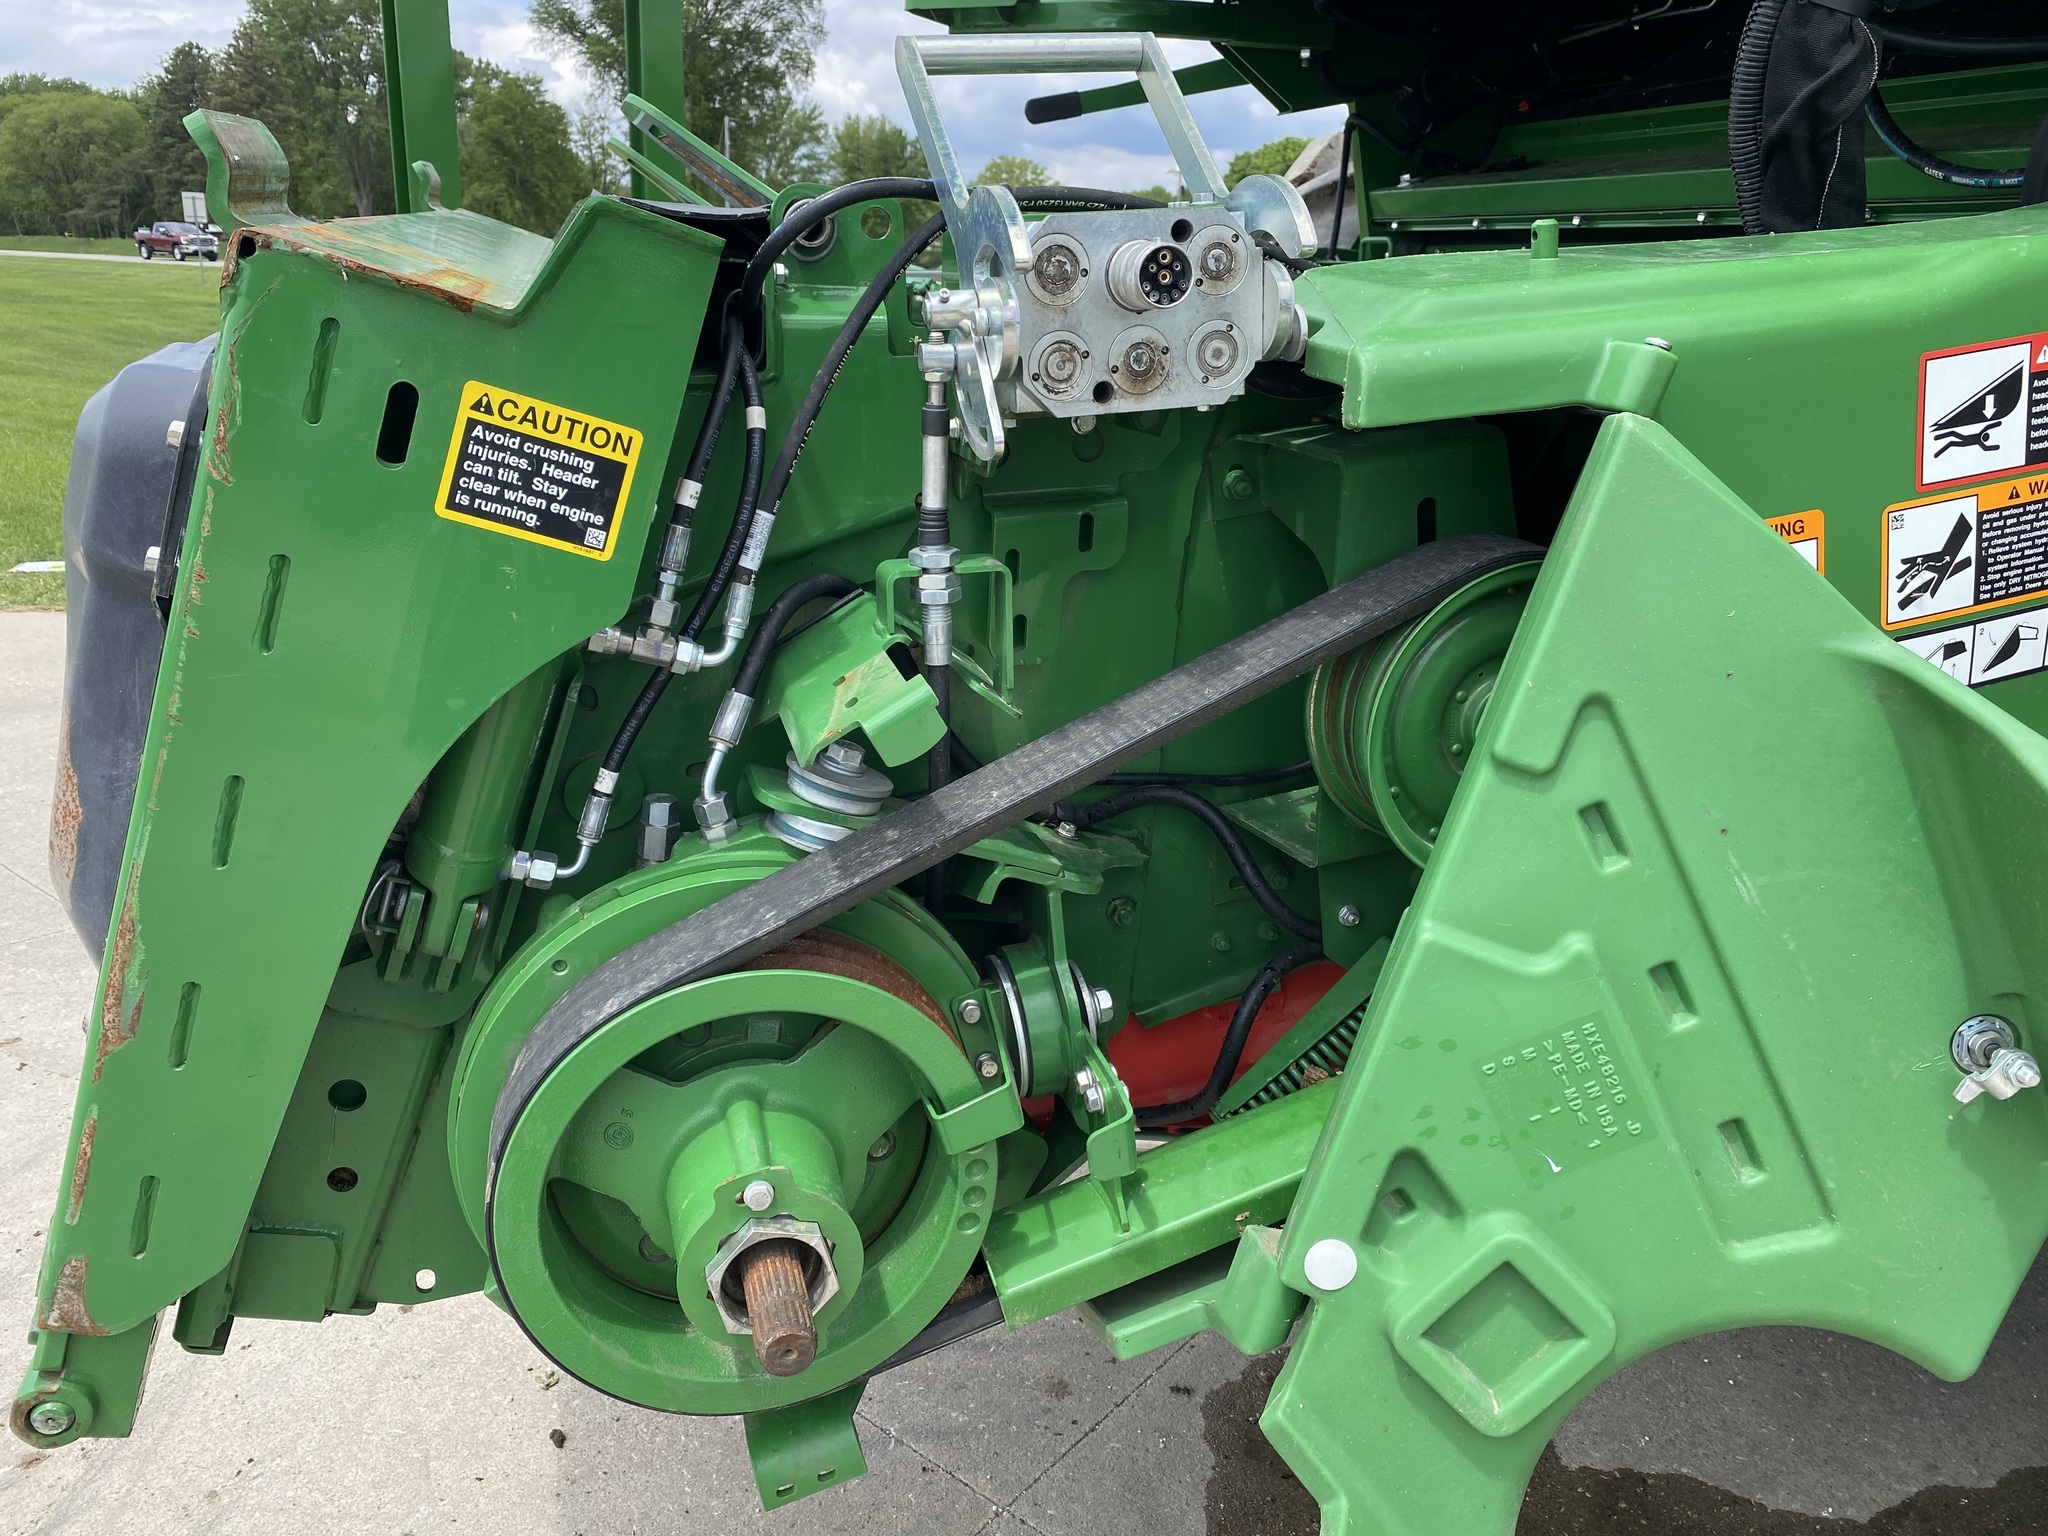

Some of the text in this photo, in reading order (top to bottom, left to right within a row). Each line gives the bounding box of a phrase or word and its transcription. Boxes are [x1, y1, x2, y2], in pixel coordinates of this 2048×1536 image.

[498, 398, 633, 457] CAUTION
[471, 425, 595, 474] Avoid crushing
[750, 433, 760, 465] MADE
[467, 441, 600, 490] injuries. Header
[463, 460, 568, 500] can tilt. Stay
[748, 472, 757, 489] IN
[455, 491, 541, 528] is running.
[459, 476, 605, 526] clear when engine
[736, 496, 753, 533] ITALY
[1982, 511, 2000, 520] Avoid
[2002, 507, 2024, 517] serious
[2026, 503, 2043, 512] injury
[1992, 519, 2004, 527] and
[2006, 518, 2017, 526] gas
[2020, 513, 2036, 522] under
[1982, 530, 2001, 539] Before
[2004, 524, 2031, 534] removing
[1988, 546, 2010, 555] Relieve
[2011, 541, 2033, 551] system
[1991, 535, 2018, 546] changing
[1996, 552, 2022, 562] Operator
[2024, 546, 2045, 555] Manual
[1987, 556, 2044, 573] system information.
[1987, 573, 2001, 581] Stop
[2003, 569, 2023, 577] engine
[2024, 564, 2036, 572] and
[1993, 580, 2007, 588] only
[2009, 577, 2021, 585] DRY
[1993, 590, 2006, 598] your
[2008, 586, 2023, 594] John
[2025, 582, 2042, 590] Deere
[1979, 628, 1985, 636] 2
[608, 719, 638, 770] MINETUFF
[1521, 1047, 1537, 1061] M
[1482, 1062, 1496, 1075] D
[1582, 1022, 1627, 1105] HXE48216
[1561, 1030, 1619, 1138] MADE IN USA
